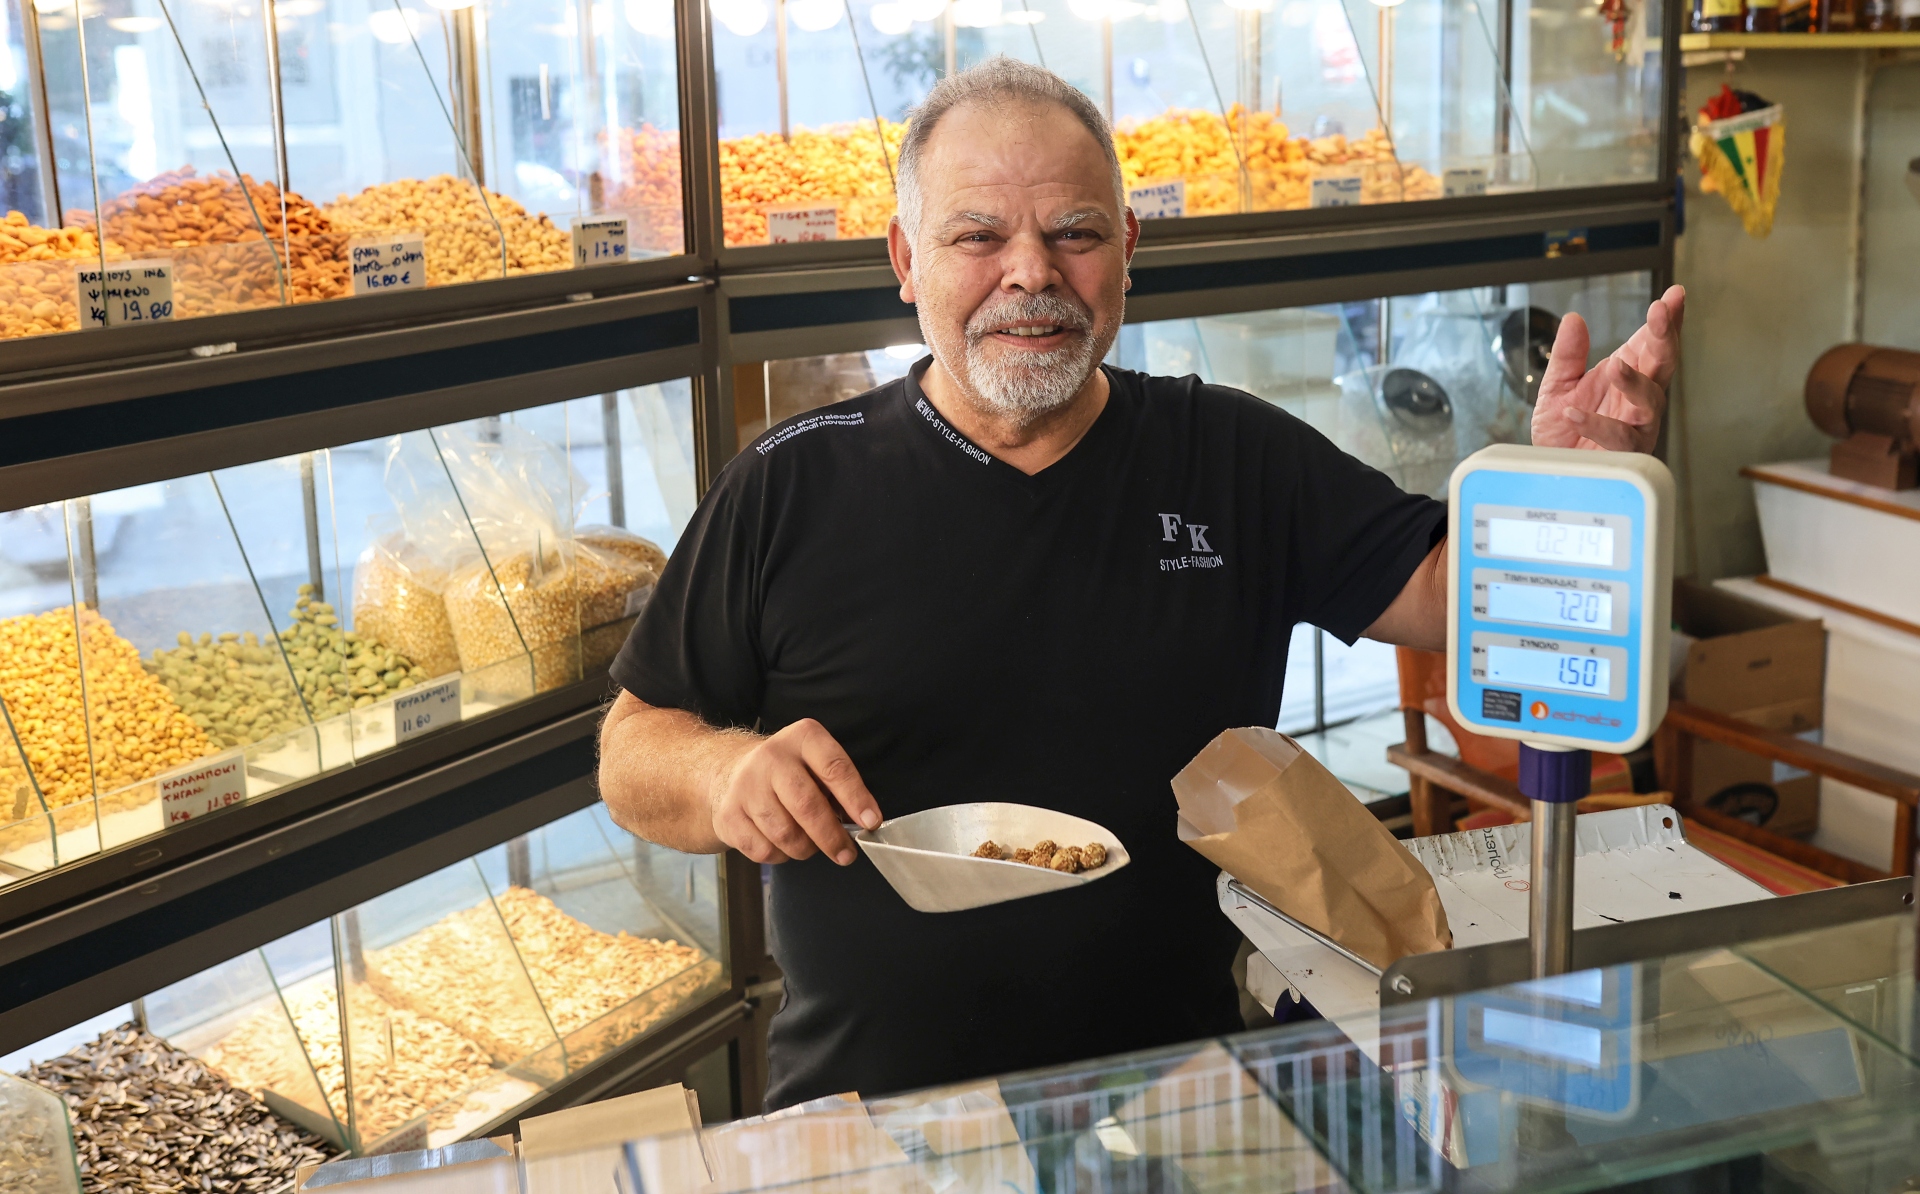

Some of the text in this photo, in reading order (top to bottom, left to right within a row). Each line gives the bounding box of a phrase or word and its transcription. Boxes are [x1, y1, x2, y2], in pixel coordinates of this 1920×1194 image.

[123, 300, 172, 320] 19.80
[755, 411, 863, 452] Men with short sleeves
[759, 417, 865, 456] The basketball movement
[1160, 554, 1223, 571] STYLE-FASHION
[1504, 573, 1529, 583] ΤΙΜΗ
[1530, 574, 1578, 588] ΜΟΝΑΔΑΣ
[1519, 639, 1560, 651] ΣΥΝΟΛΟ
[206, 791, 240, 812] 11.80
